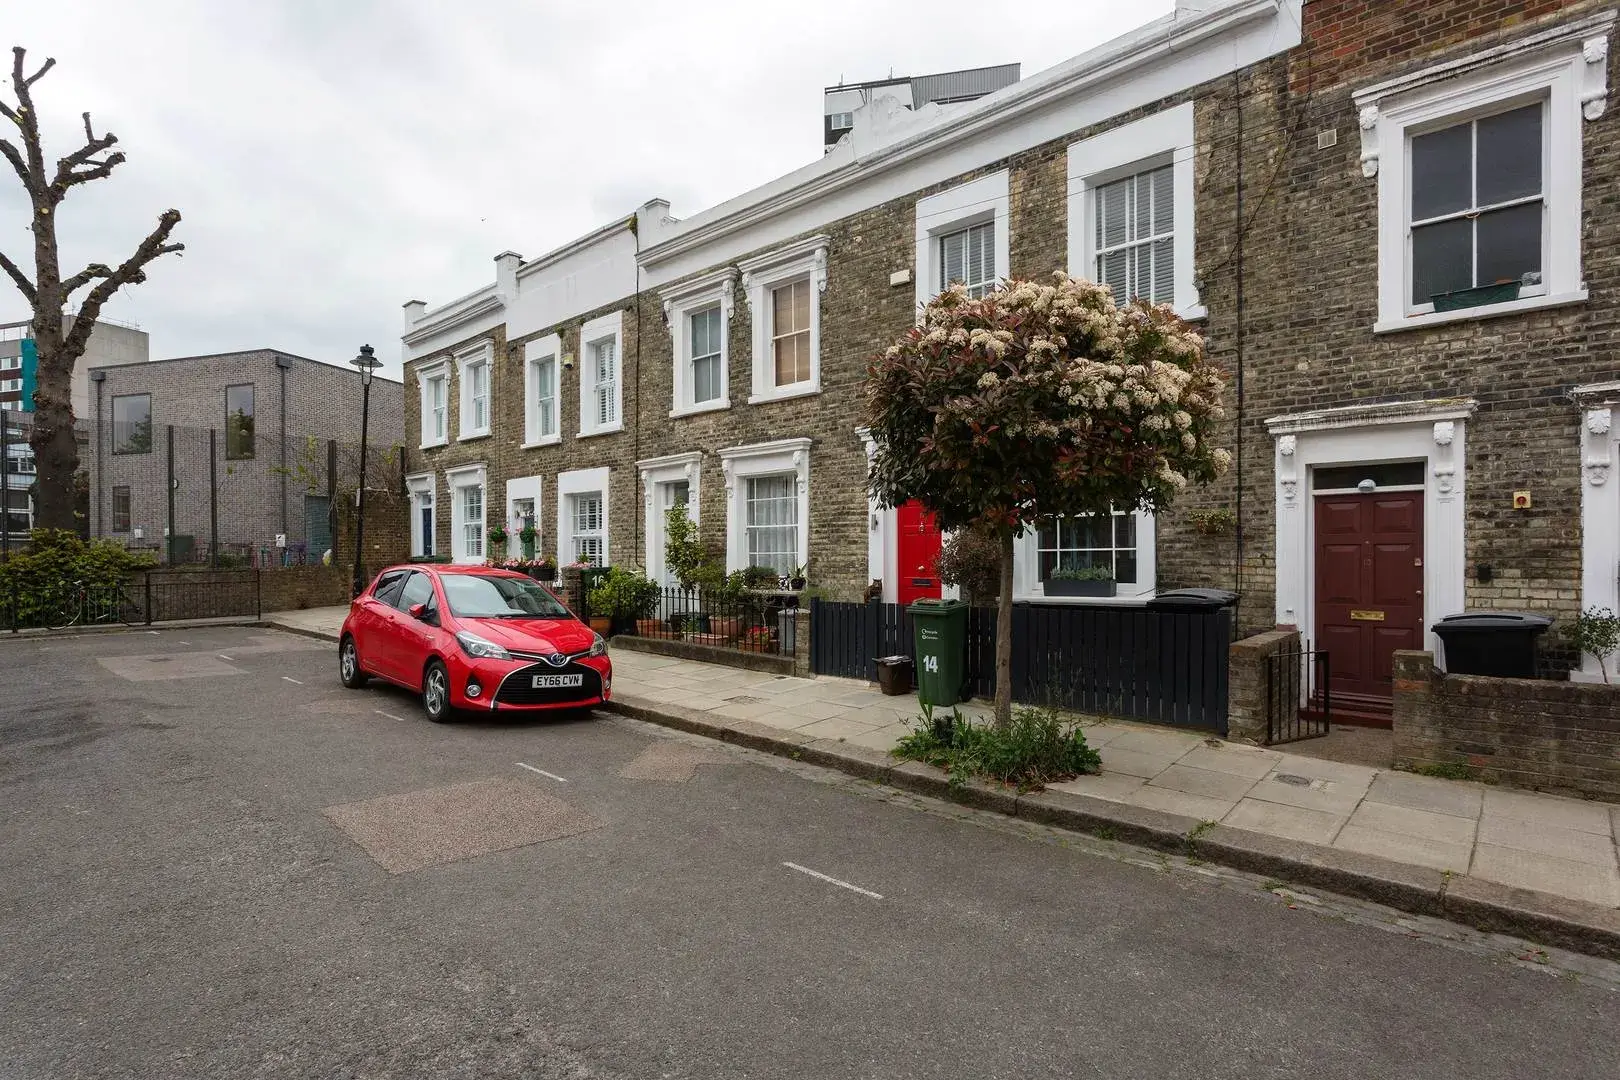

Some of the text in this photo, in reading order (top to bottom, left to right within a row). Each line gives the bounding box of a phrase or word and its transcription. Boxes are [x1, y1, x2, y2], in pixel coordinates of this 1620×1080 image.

[923, 655, 938, 673] 14
[536, 675, 580, 686] EY66 CVN
